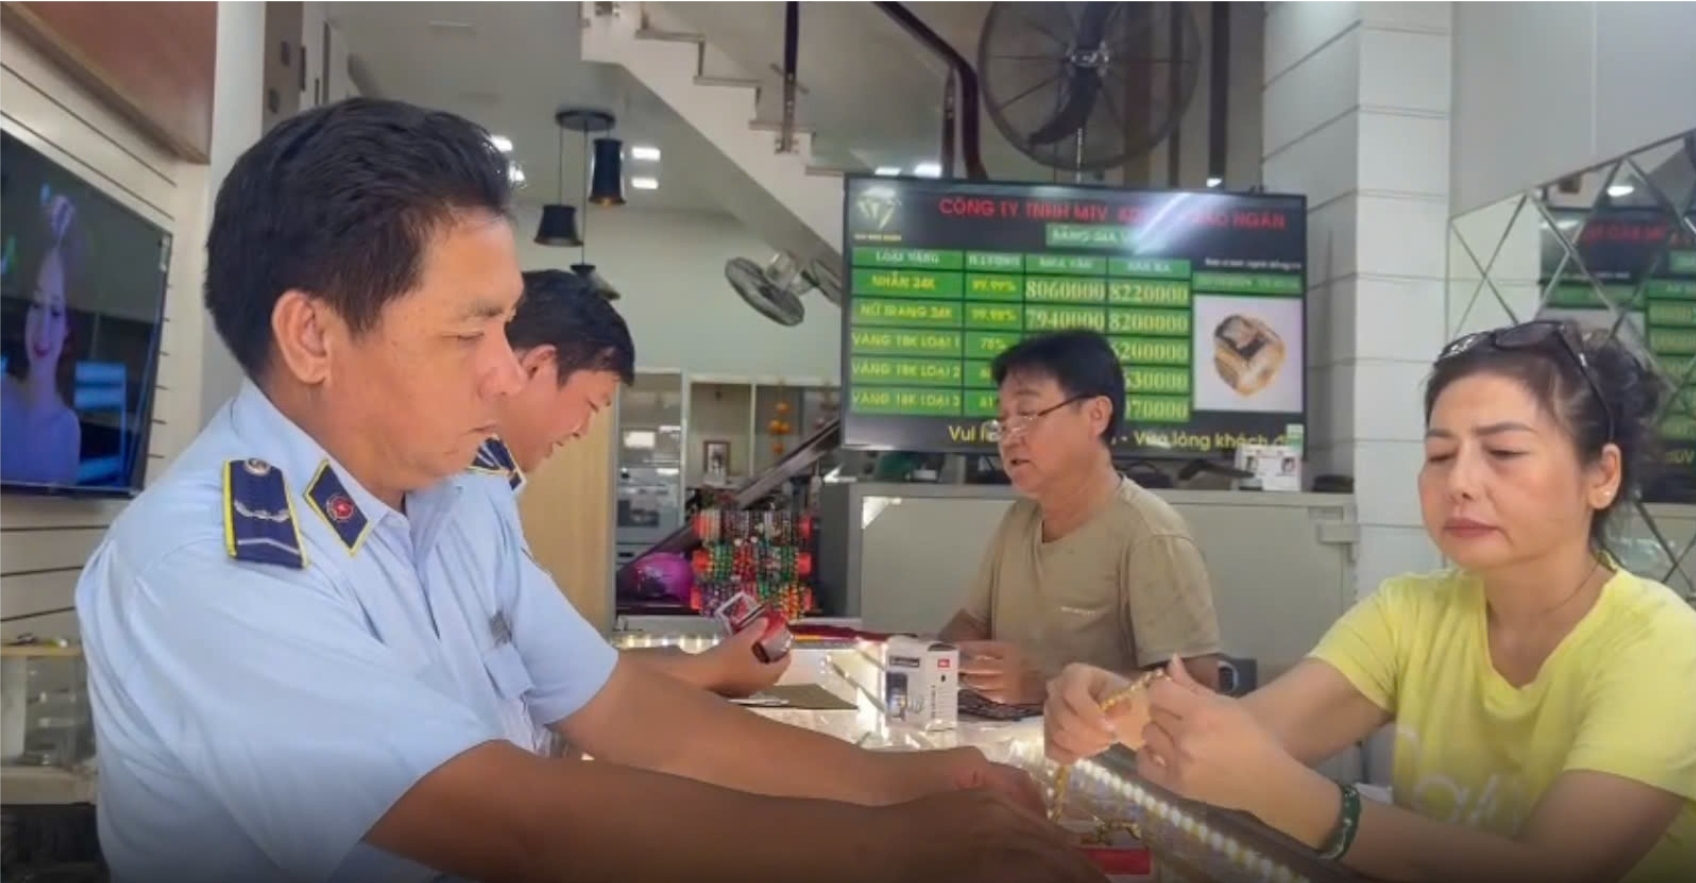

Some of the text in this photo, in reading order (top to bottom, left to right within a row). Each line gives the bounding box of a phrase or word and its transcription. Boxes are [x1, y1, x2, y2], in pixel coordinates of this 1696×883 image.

[939, 195, 995, 217] CÔNG
[1000, 200, 1018, 217] TY
[1026, 201, 1069, 219] TNHH
[1074, 204, 1107, 221] MTV
[1026, 281, 1105, 299] 8060000
[1110, 284, 1188, 303] 8220000
[1109, 313, 1188, 333] 8200000
[953, 367, 961, 379] 2
